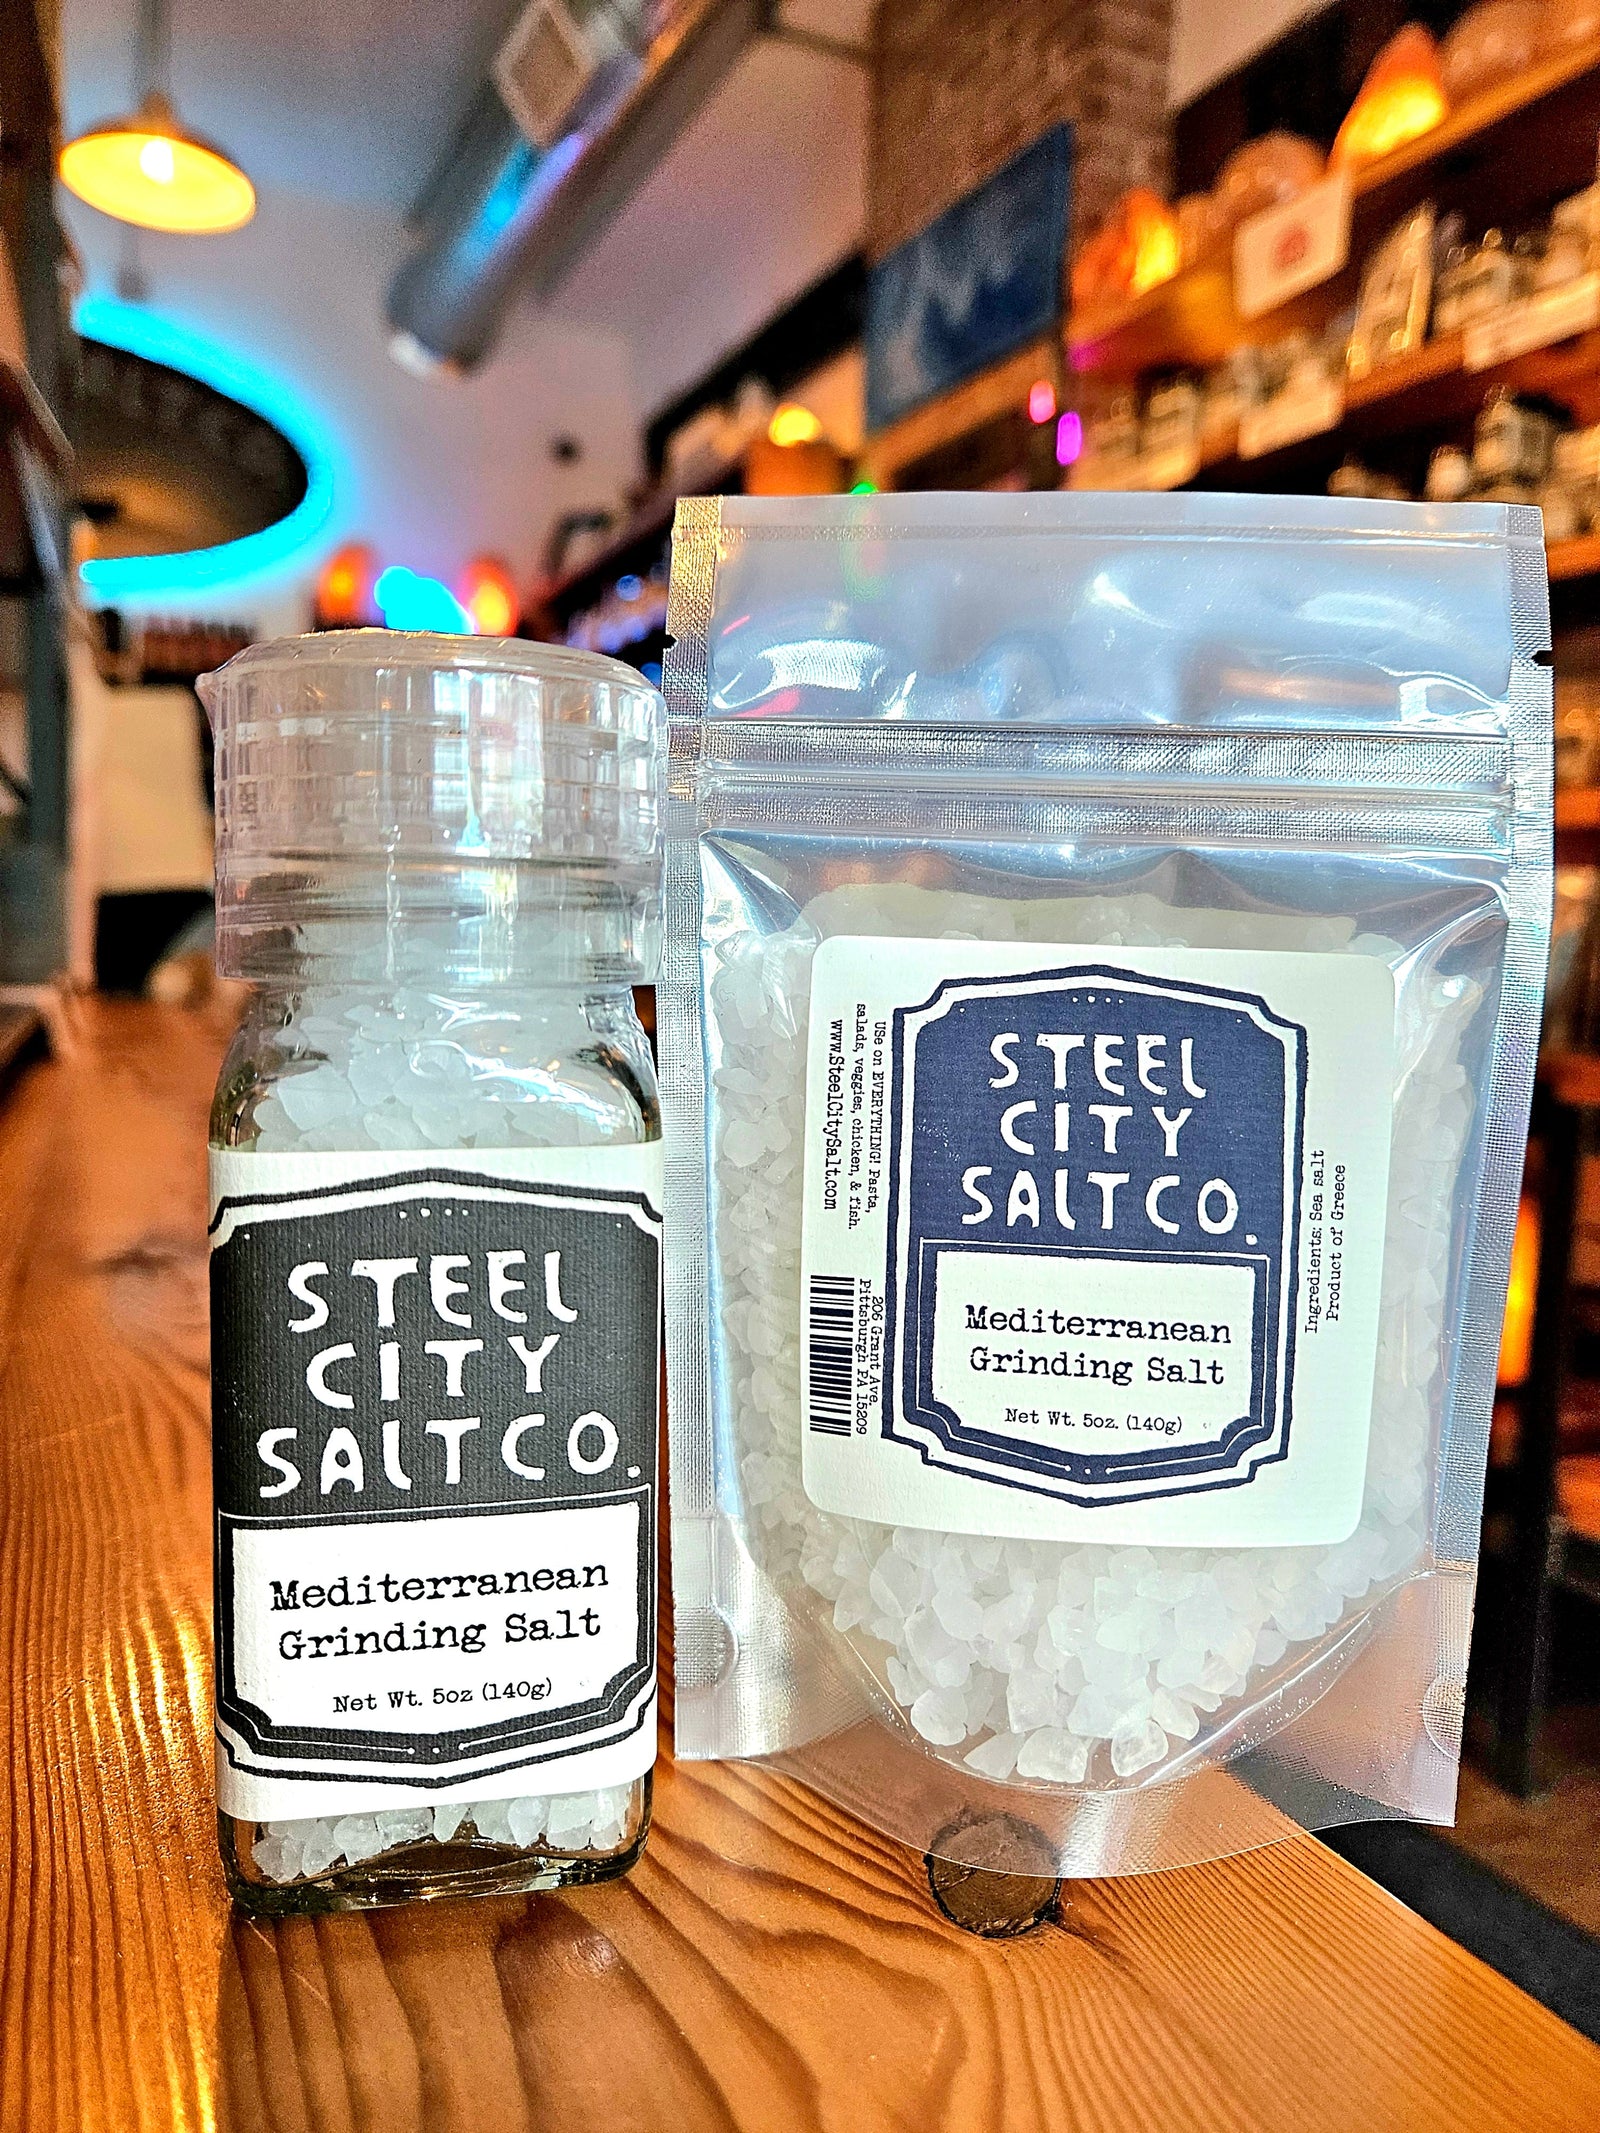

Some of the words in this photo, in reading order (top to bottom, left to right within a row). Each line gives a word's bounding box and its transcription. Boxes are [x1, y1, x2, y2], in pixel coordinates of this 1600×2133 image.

[854, 1003, 868, 1052] salads,
[873, 1050, 883, 1066] on
[989, 1033, 1206, 1098] STEEL
[850, 1057, 864, 1114] veggies,
[823, 1019, 845, 1210] www.SteelCitySalt.com
[870, 1070, 885, 1164] EVERYTHING!
[1001, 1101, 1193, 1156] CITY
[848, 1118, 863, 1176] chicken,
[1310, 1150, 1325, 1187] salt
[849, 1181, 861, 1191] &
[865, 1170, 881, 1213] Pasta,
[1309, 1194, 1323, 1221] Sea
[1331, 1164, 1346, 1221] Greece
[848, 1198, 863, 1230] fish.
[1330, 1227, 1343, 1246] of
[288, 1250, 578, 1333] STEEL
[1305, 1227, 1322, 1334] Ingredients:
[1326, 1252, 1342, 1321] Product
[855, 1278, 872, 1363] Pittsburgh
[872, 1296, 884, 1321] 206
[965, 1305, 1232, 1344] Mediterranean
[870, 1326, 882, 1370] Grant
[970, 1347, 1133, 1386] Grinding
[1147, 1357, 1225, 1385] Salt
[307, 1334, 561, 1409] CITY
[857, 1368, 869, 1388] PA
[868, 1374, 881, 1406] Ave.
[856, 1394, 868, 1435] 15209
[1004, 1407, 1040, 1425] Net
[1047, 1410, 1076, 1427] Wt.
[1082, 1413, 1119, 1430] 5oz.
[1126, 1414, 1183, 1435] (140g)
[269, 1562, 609, 1612] Mediterranean
[278, 1621, 487, 1661] Grinding
[505, 1606, 602, 1644] Salt
[332, 1693, 378, 1713] Net
[387, 1690, 423, 1709] Wt.
[432, 1687, 473, 1705] 5oz
[482, 1676, 552, 1702] (140g)
